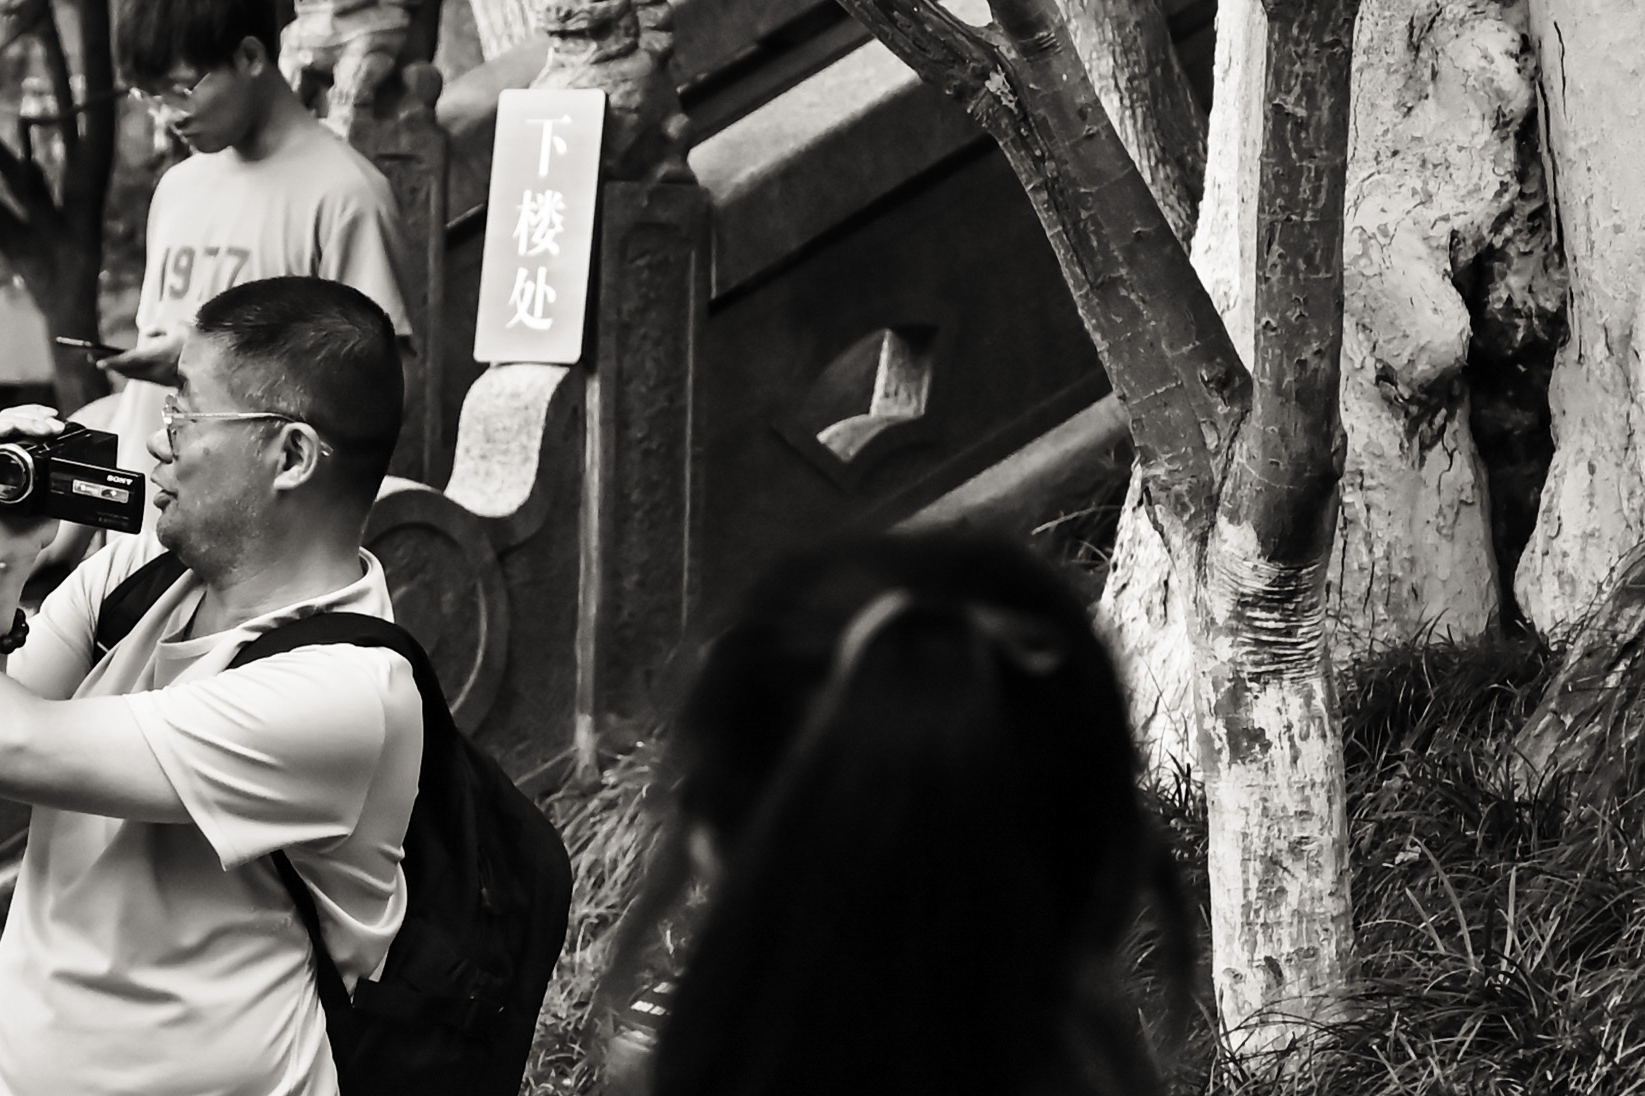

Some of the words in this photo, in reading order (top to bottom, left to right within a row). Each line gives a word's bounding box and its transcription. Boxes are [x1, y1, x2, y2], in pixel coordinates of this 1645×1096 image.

[506, 114, 572, 330] 下楼处
[106, 474, 133, 486] SONY
